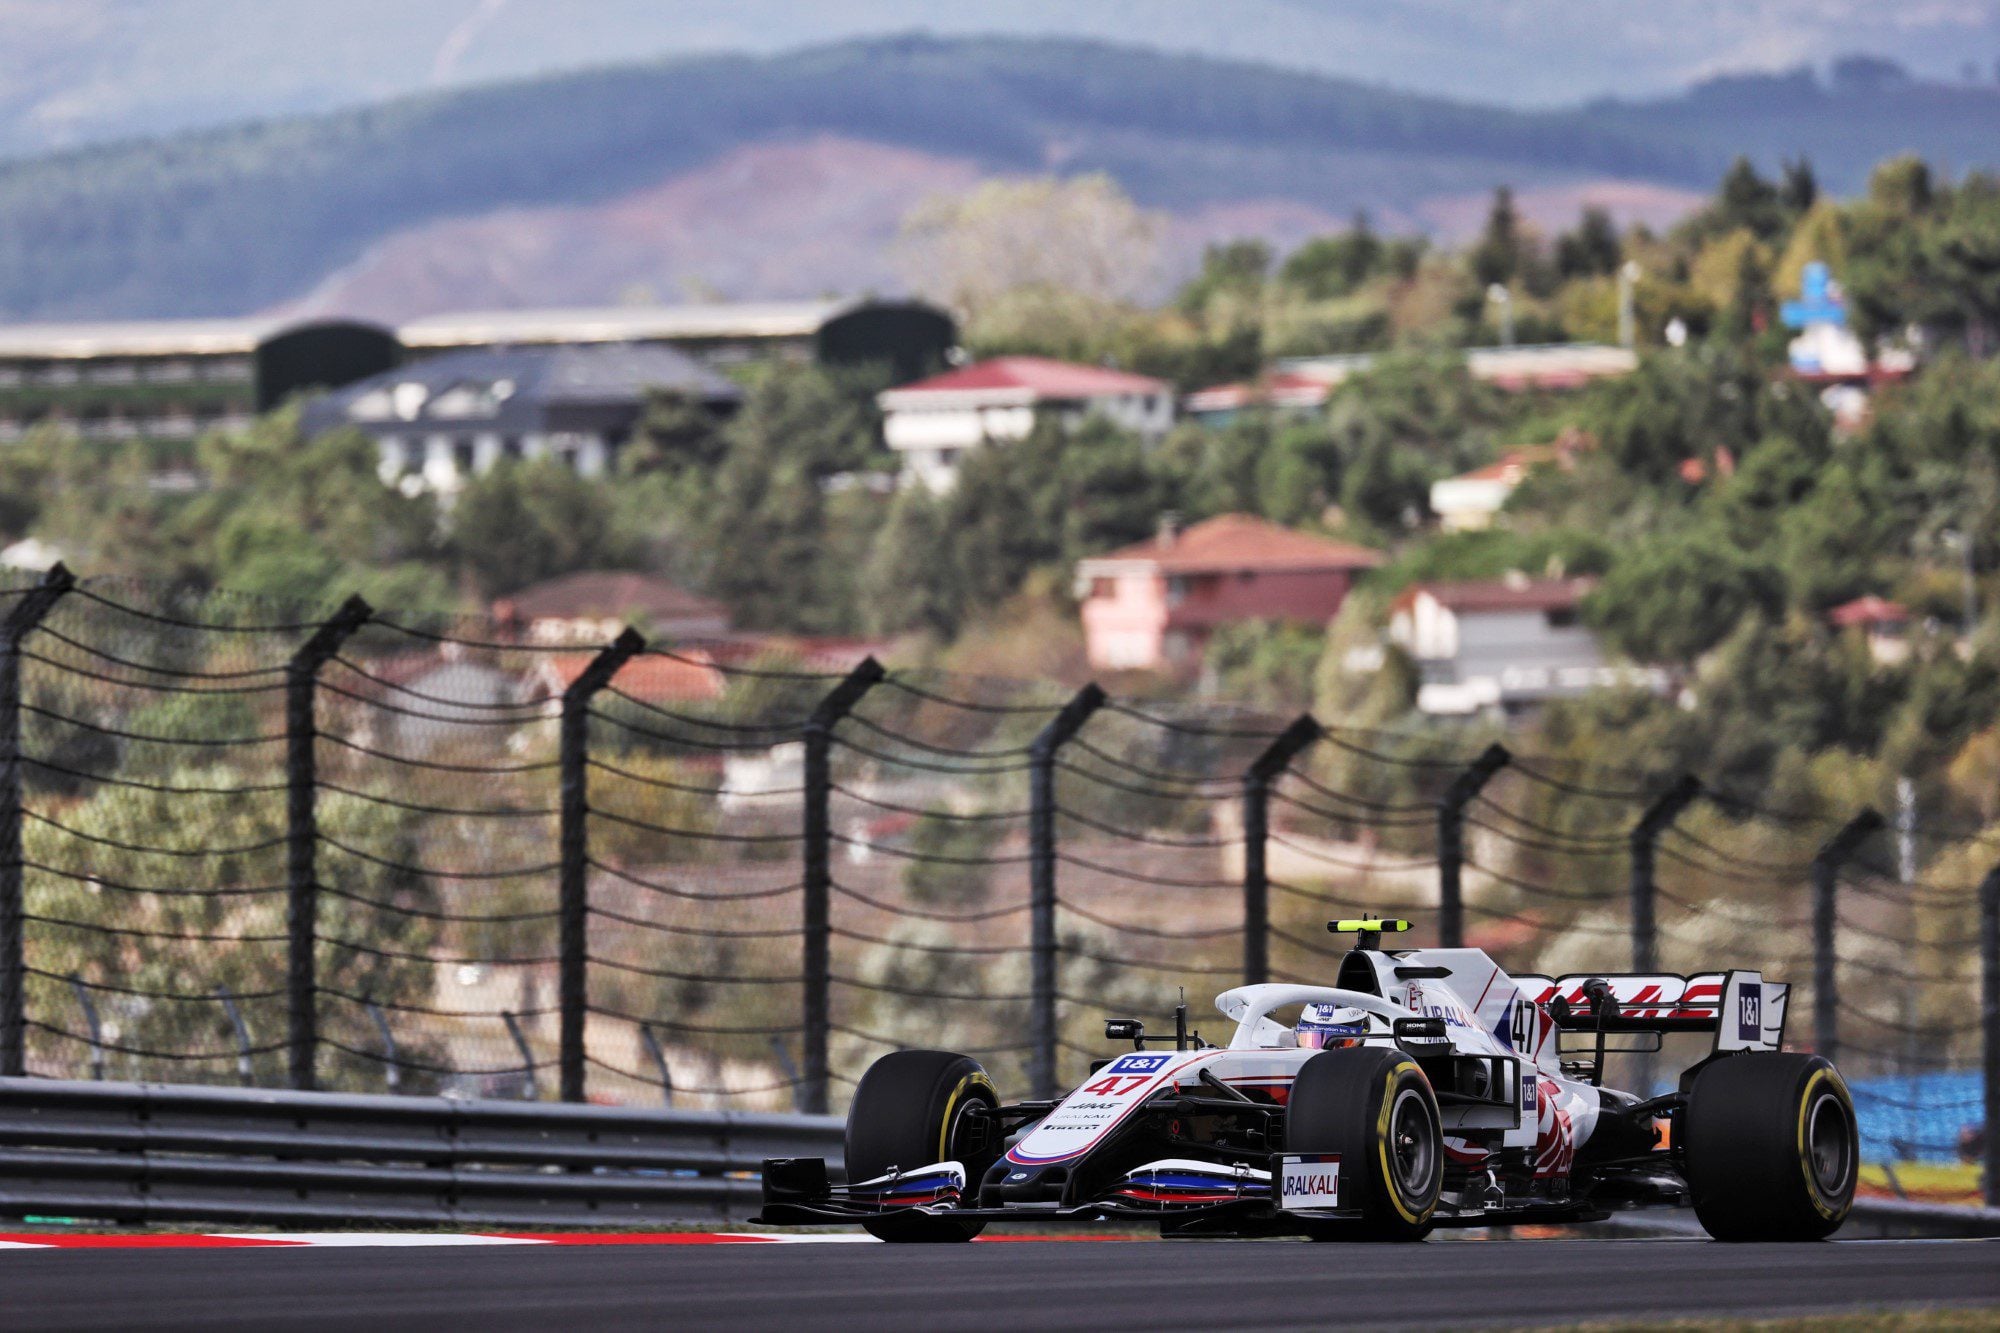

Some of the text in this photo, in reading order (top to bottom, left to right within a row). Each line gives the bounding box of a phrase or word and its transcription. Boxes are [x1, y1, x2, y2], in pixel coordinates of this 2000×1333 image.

[1319, 1005, 1333, 1013] 1&1
[1740, 996, 1759, 1026] 1&1
[1512, 1000, 1536, 1054] 47
[1120, 1059, 1165, 1069] 1&1
[1083, 1076, 1153, 1095] 47
[1522, 1084, 1535, 1102] 1&1
[1283, 1175, 1337, 1196] URALKALI
